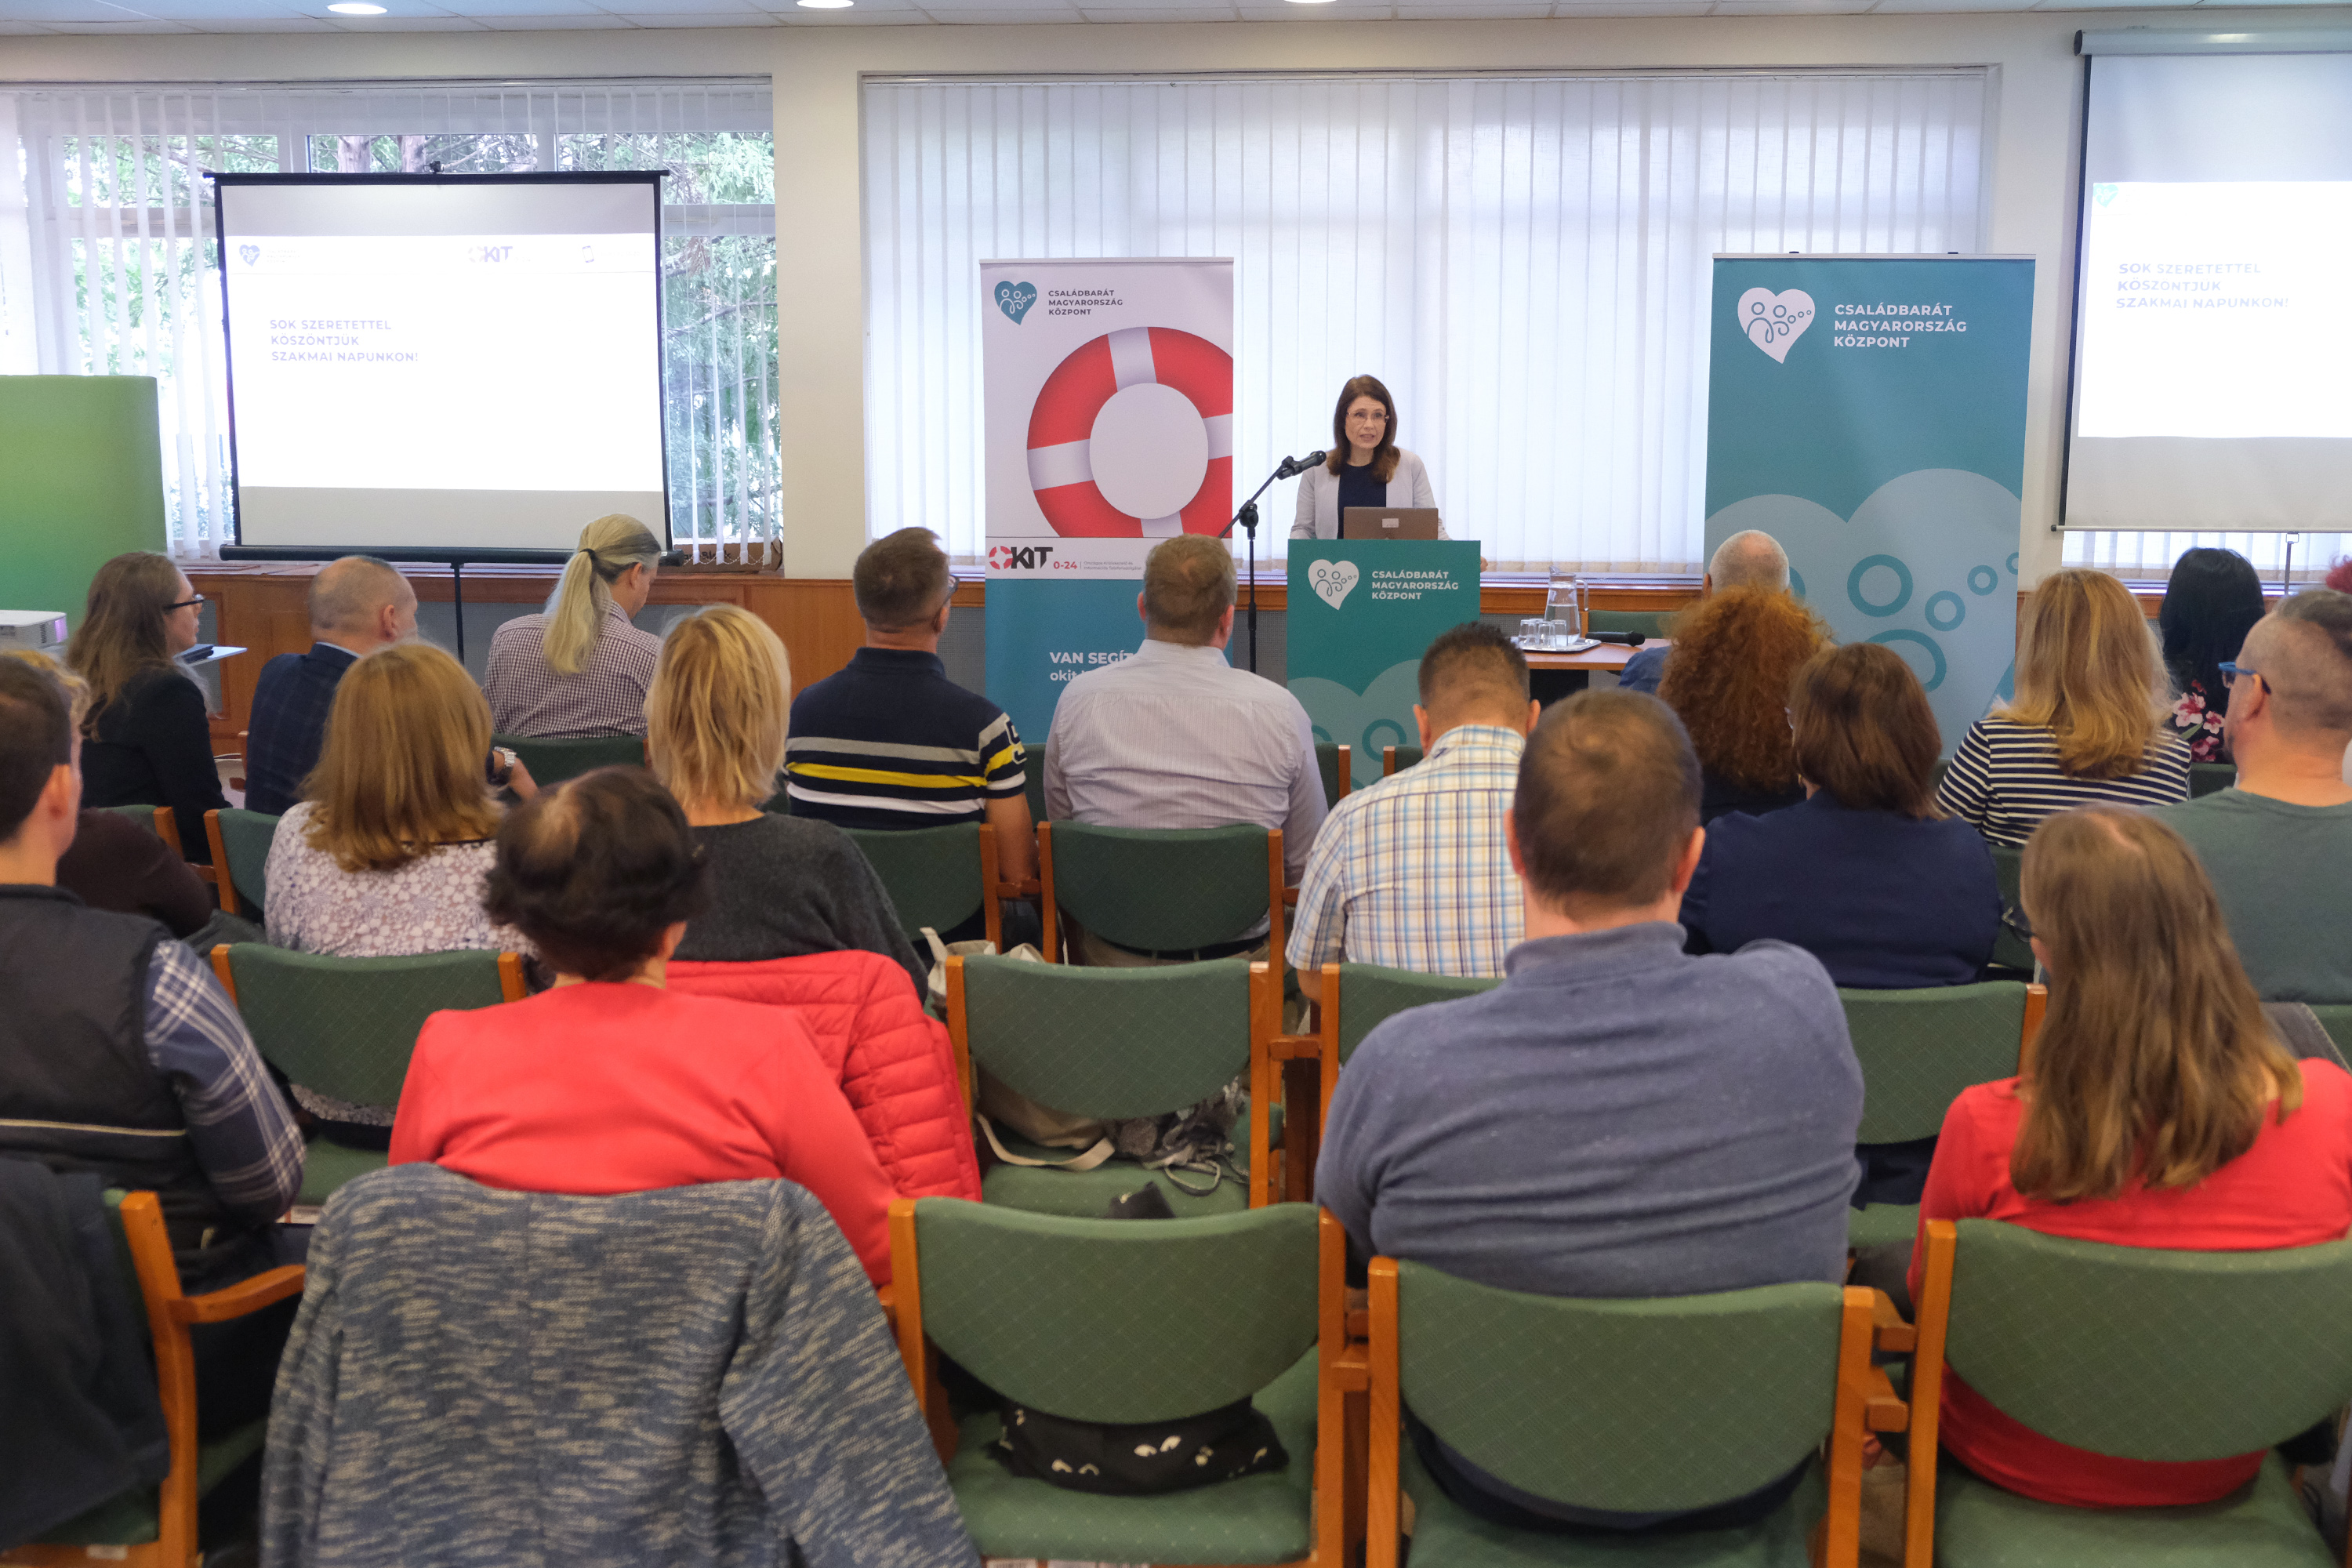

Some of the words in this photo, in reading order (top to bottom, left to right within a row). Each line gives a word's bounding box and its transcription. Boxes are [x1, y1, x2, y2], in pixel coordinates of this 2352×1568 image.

[2118, 263, 2151, 274] SOK
[2157, 263, 2261, 274] SZERETETTEL
[2117, 278, 2221, 292] KÖSZÖNTJÜK
[2116, 297, 2187, 309] SZAKMAI
[2193, 297, 2288, 309] NAPUNKON!
[1048, 307, 1091, 316] KÖZPONT
[1835, 303, 1953, 316] CSALÁDBARÁT
[270, 319, 296, 330] SOK
[301, 319, 392, 330] SZERETETTEL
[1834, 318, 1967, 332] MAGYARORSZÁG
[270, 332, 359, 346] KÖSZÖNTJÜK
[1834, 334, 1910, 348] KÖZPONT
[271, 350, 332, 361] SZAKMAI
[337, 352, 418, 362] NAPUNKON!
[1053, 561, 1078, 570] 0-24
[1372, 570, 1449, 579] CSALÁDBARÁT
[1372, 580, 1459, 590] MAGYARORSZÁG
[1372, 591, 1422, 600] KÖZPONT
[1049, 652, 1083, 664] VAN
